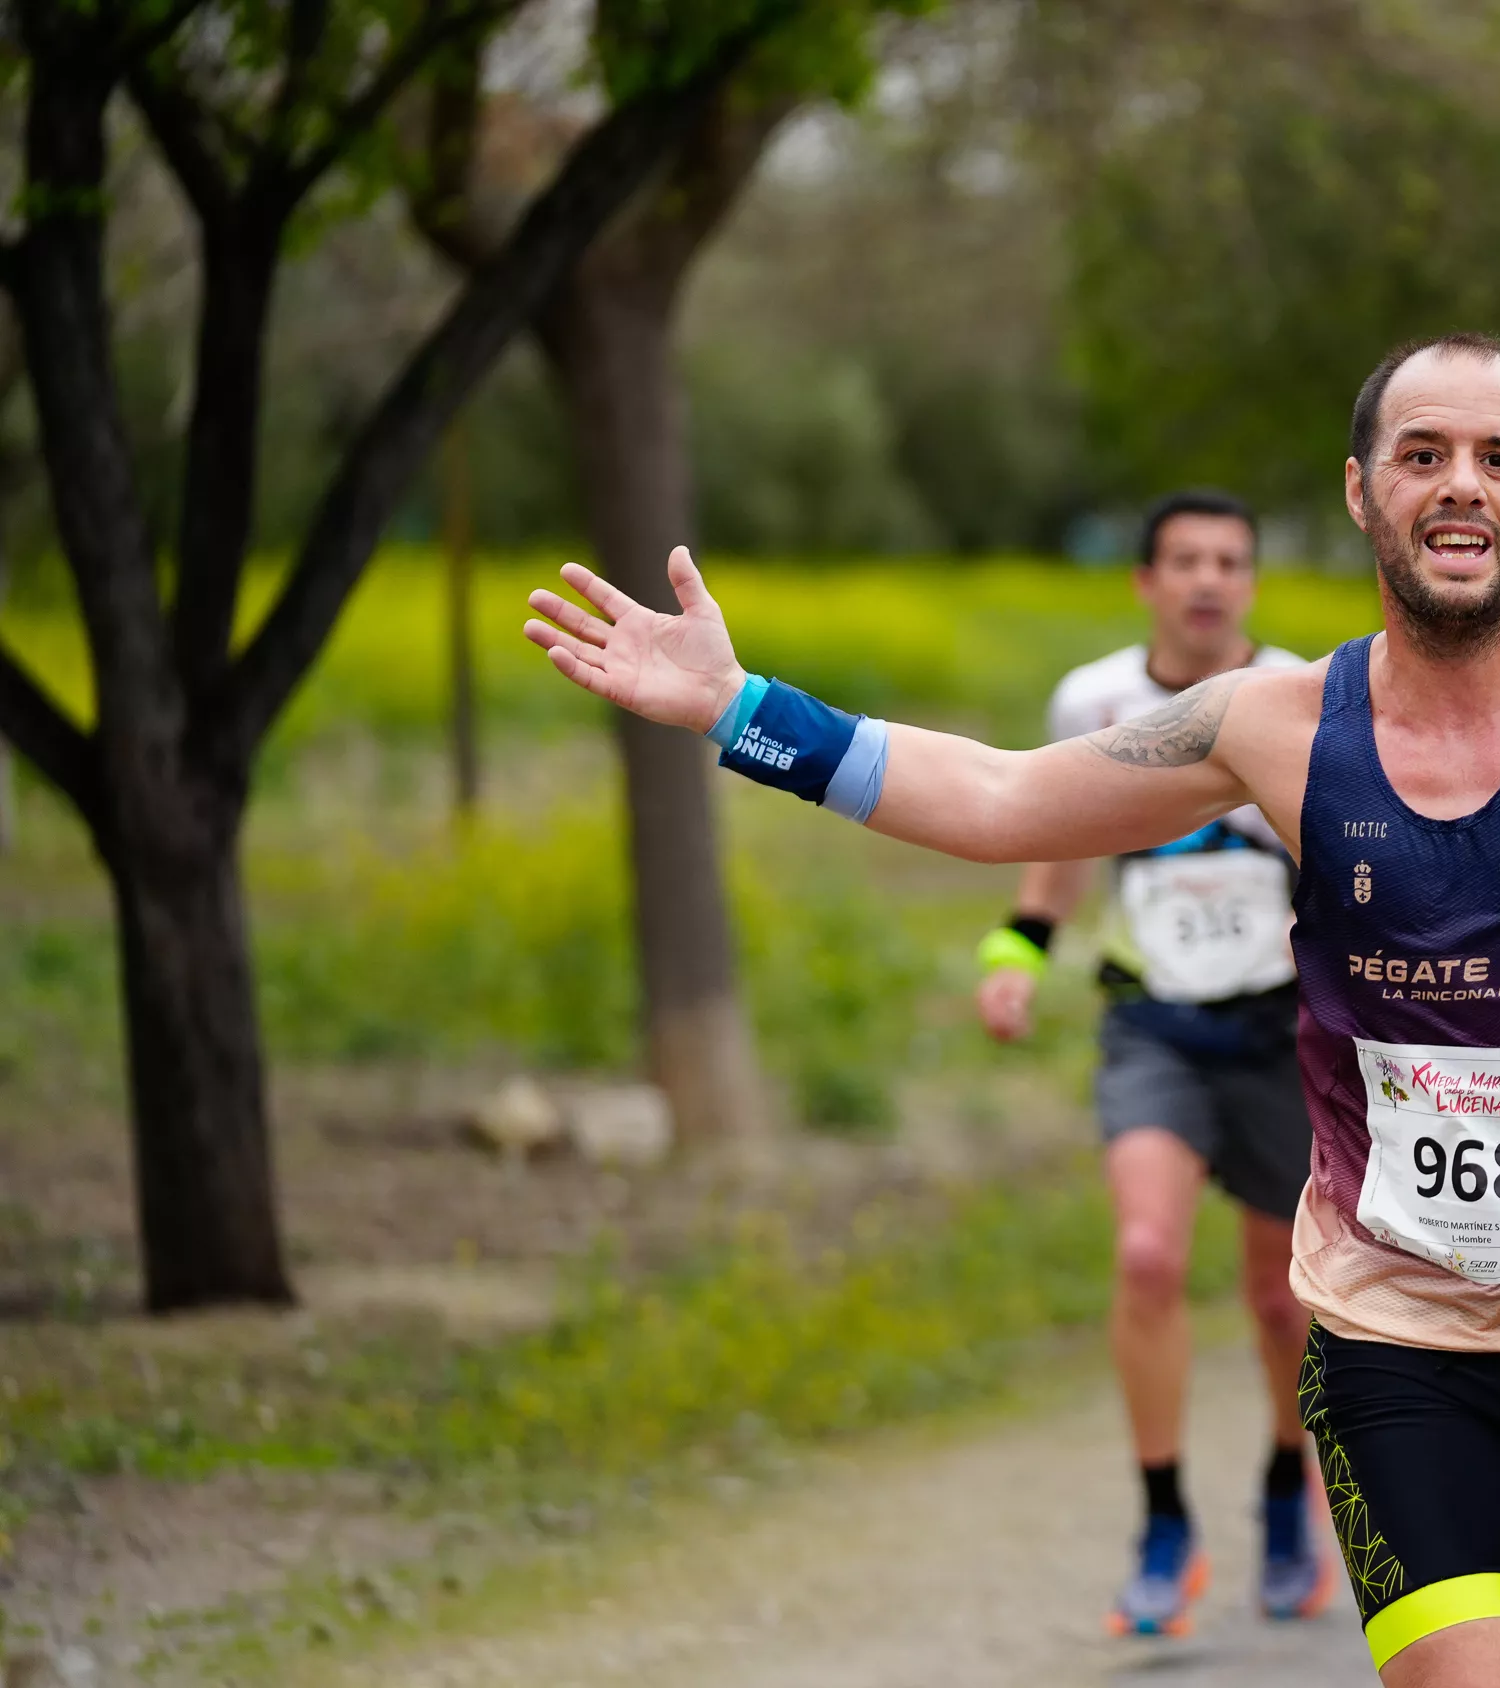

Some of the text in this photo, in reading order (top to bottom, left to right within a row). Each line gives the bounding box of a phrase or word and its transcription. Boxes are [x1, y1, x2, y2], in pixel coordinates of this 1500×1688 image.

[760, 735, 783, 750] YOUR
[785, 746, 798, 755] OF
[1343, 821, 1388, 839] TACTIC
[1349, 949, 1491, 984] PÉGATE
[1382, 988, 1404, 1000] LA
[1418, 1216, 1449, 1229] ROBERTO
[1450, 1219, 1493, 1231] MARTÍNEZ
[1451, 1235, 1492, 1244] L-Hombre
